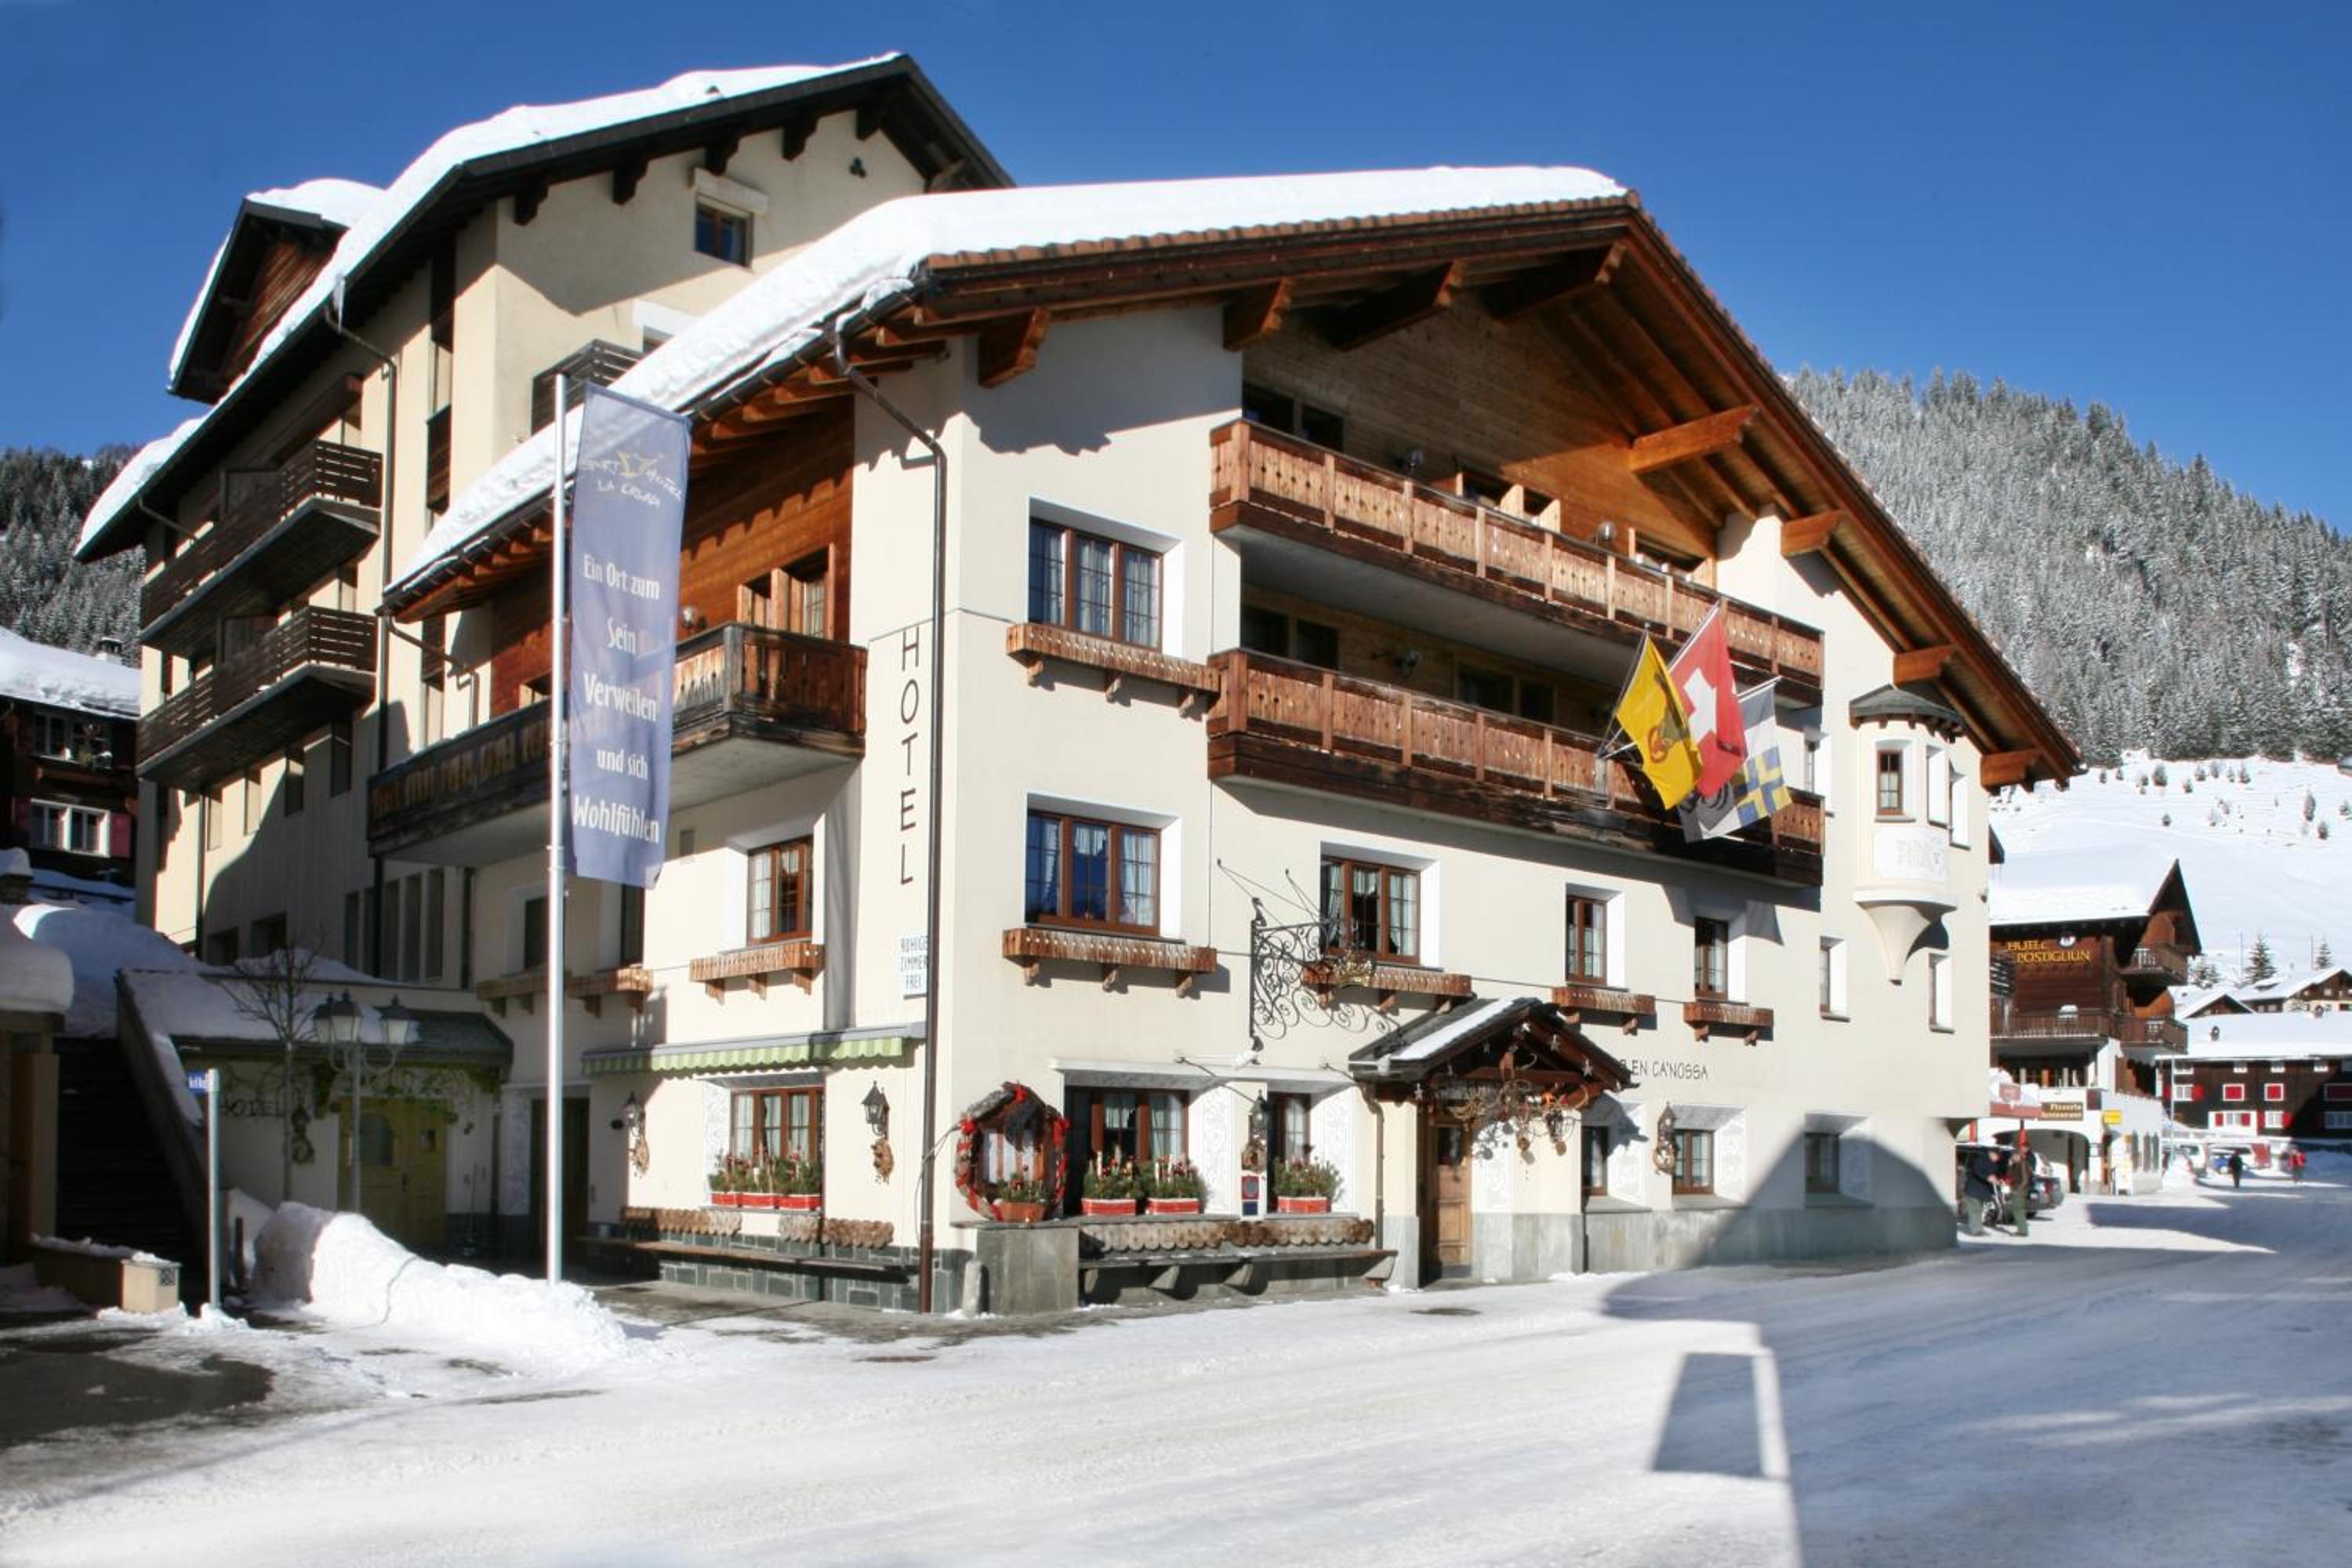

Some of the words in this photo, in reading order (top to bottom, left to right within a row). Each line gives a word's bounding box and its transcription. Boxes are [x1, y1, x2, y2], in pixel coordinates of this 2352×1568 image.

[597, 479, 615, 492] LA
[583, 554, 603, 583] Ein
[606, 562, 627, 591] Ort
[631, 575, 660, 600] zum
[607, 616, 637, 654] Sein
[583, 673, 656, 722] Verweilen
[597, 748, 624, 774] und
[627, 753, 648, 779] sich
[900, 626, 920, 886] HOTEL
[573, 795, 659, 844] Wohlfühlen
[2007, 940, 2046, 951] HOTEL
[906, 974, 921, 990] FREI
[1632, 1059, 1648, 1076] EN
